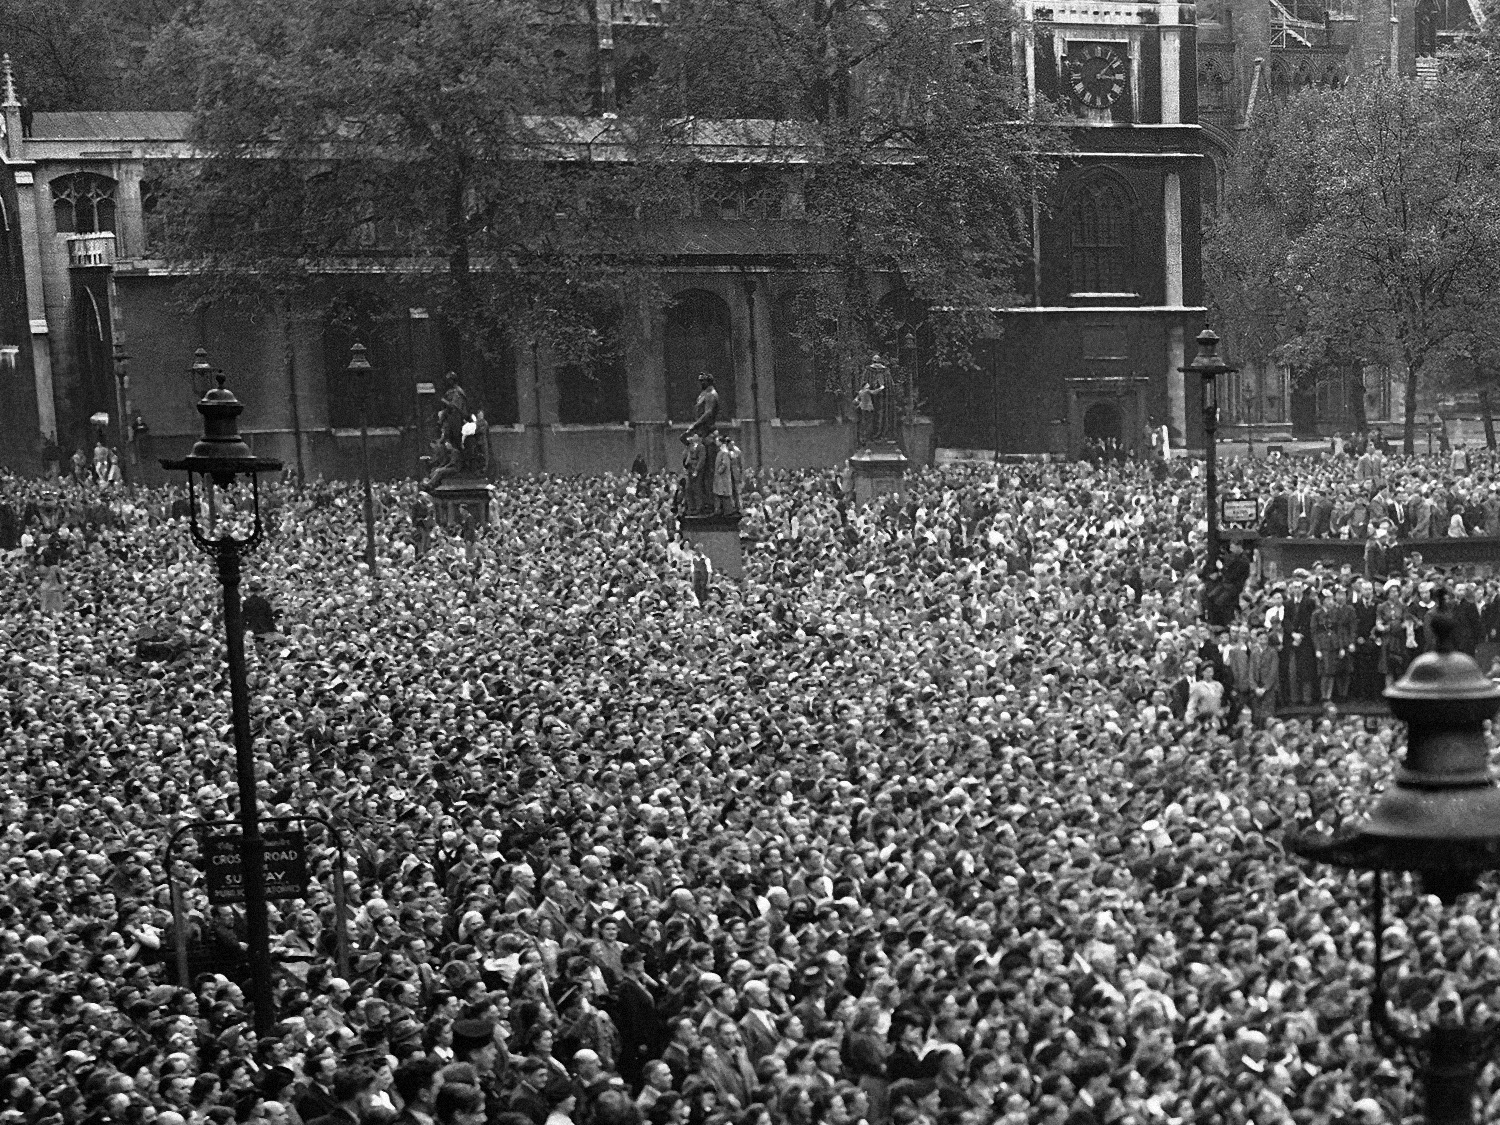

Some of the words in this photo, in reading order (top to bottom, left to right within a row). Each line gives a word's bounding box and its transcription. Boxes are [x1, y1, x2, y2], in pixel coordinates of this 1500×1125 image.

[212, 853, 242, 866] CROS
[263, 849, 298, 862] ROAD
[224, 870, 286, 885] SUAY
